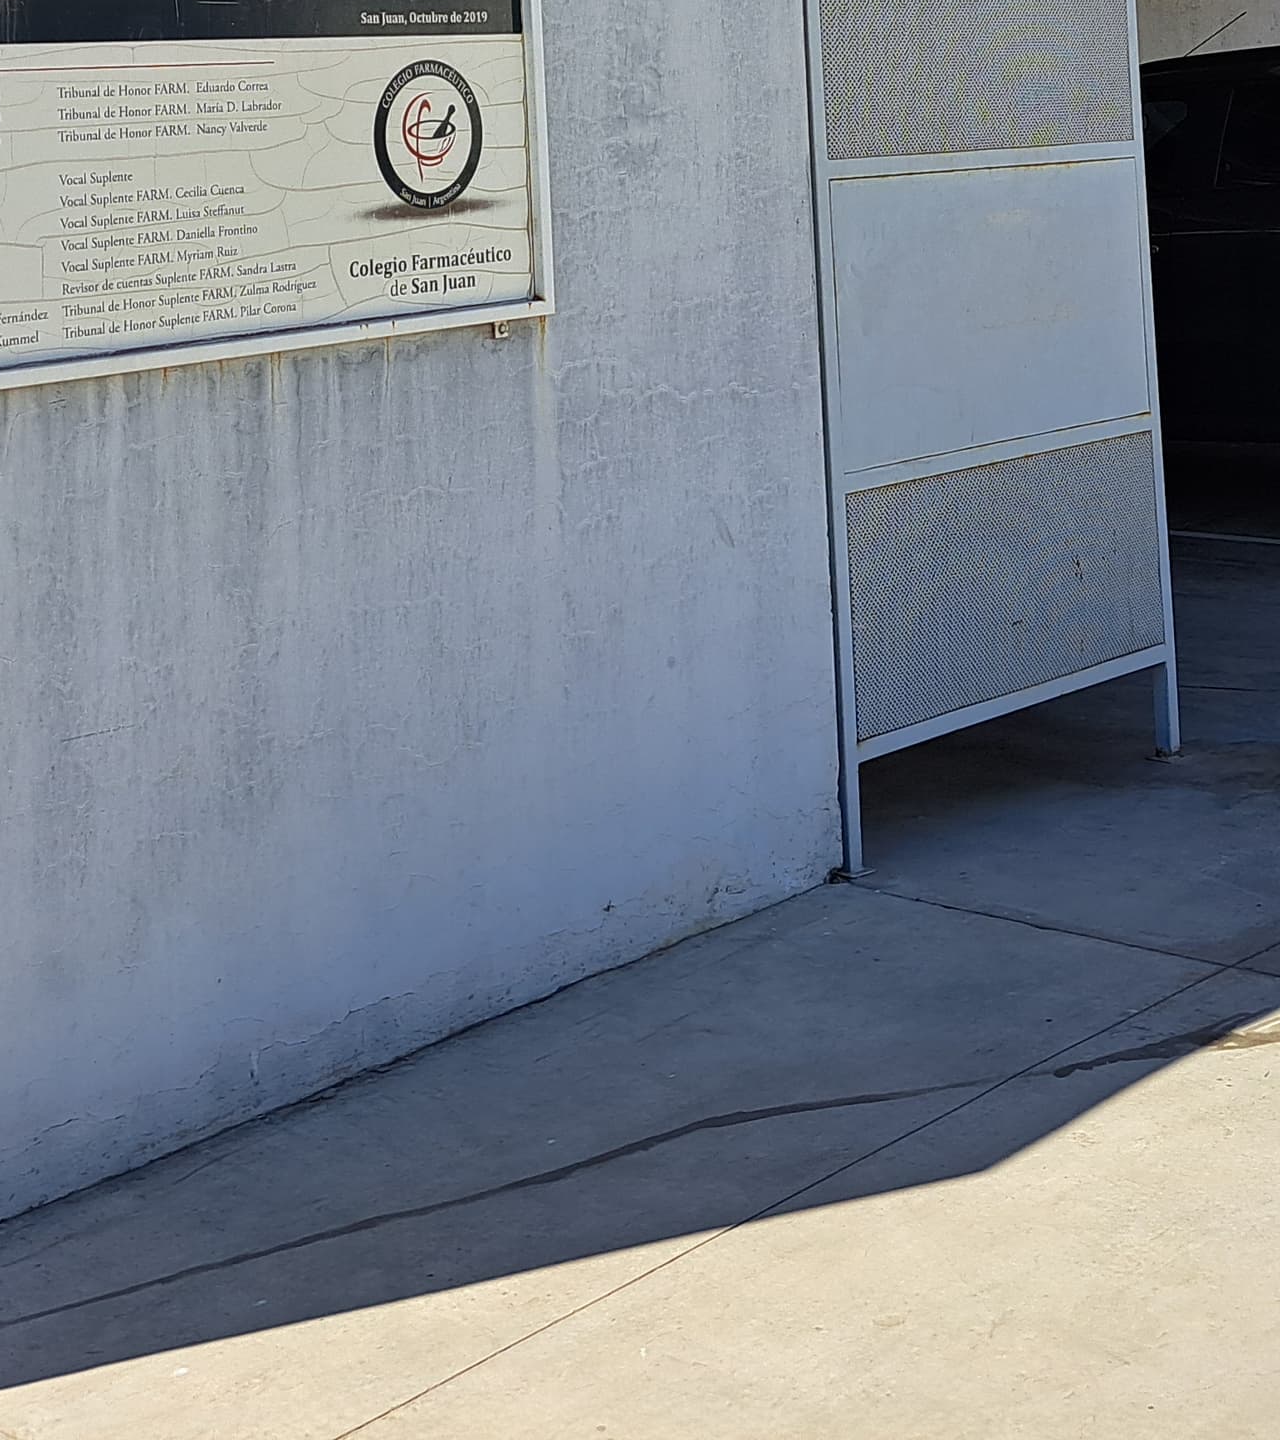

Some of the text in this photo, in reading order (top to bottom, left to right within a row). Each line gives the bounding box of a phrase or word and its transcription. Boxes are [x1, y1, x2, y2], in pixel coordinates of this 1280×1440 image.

[360, 11, 489, 27] San Juan, Octubre de 2019
[57, 80, 269, 99] Tribunal de Honor FARM. Eduardo Correa
[382, 63, 473, 109] COLEGIO FARMACÉUTICO
[58, 100, 282, 121] Tribunal de Honor FARM. María D. Labrador
[58, 120, 268, 143] Tribunal de Honor FARM. Nancy Valverde
[59, 171, 133, 187] Vocal Suplente
[59, 184, 245, 208] Vocal Suplente FARM. Cecilia Cuenca
[400, 188, 411, 201] San
[412, 194, 426, 206] Juan
[60, 202, 245, 230] Vocal Suplente FARM. Luisa Steffanut
[61, 223, 258, 252] Vocal Suplente FARM. Daniella Frontino
[61, 245, 238, 273] Vocal Suplente FARM. Myriam Ruiz
[350, 247, 512, 278] Colegio Farmacéutico
[62, 261, 296, 296] Revisor de cuentas Suplente FARM. Sandra Lastra
[390, 274, 476, 296] de San Juan
[62, 303, 105, 318] Tribunal
[108, 300, 120, 312] de
[123, 297, 156, 311] Honor
[159, 292, 199, 307] Suplente
[202, 287, 237, 301] FARM.
[240, 283, 269, 297] Zulma
[62, 301, 297, 340] Tribunal de Honor Suplente FARM. Pilar Corona
